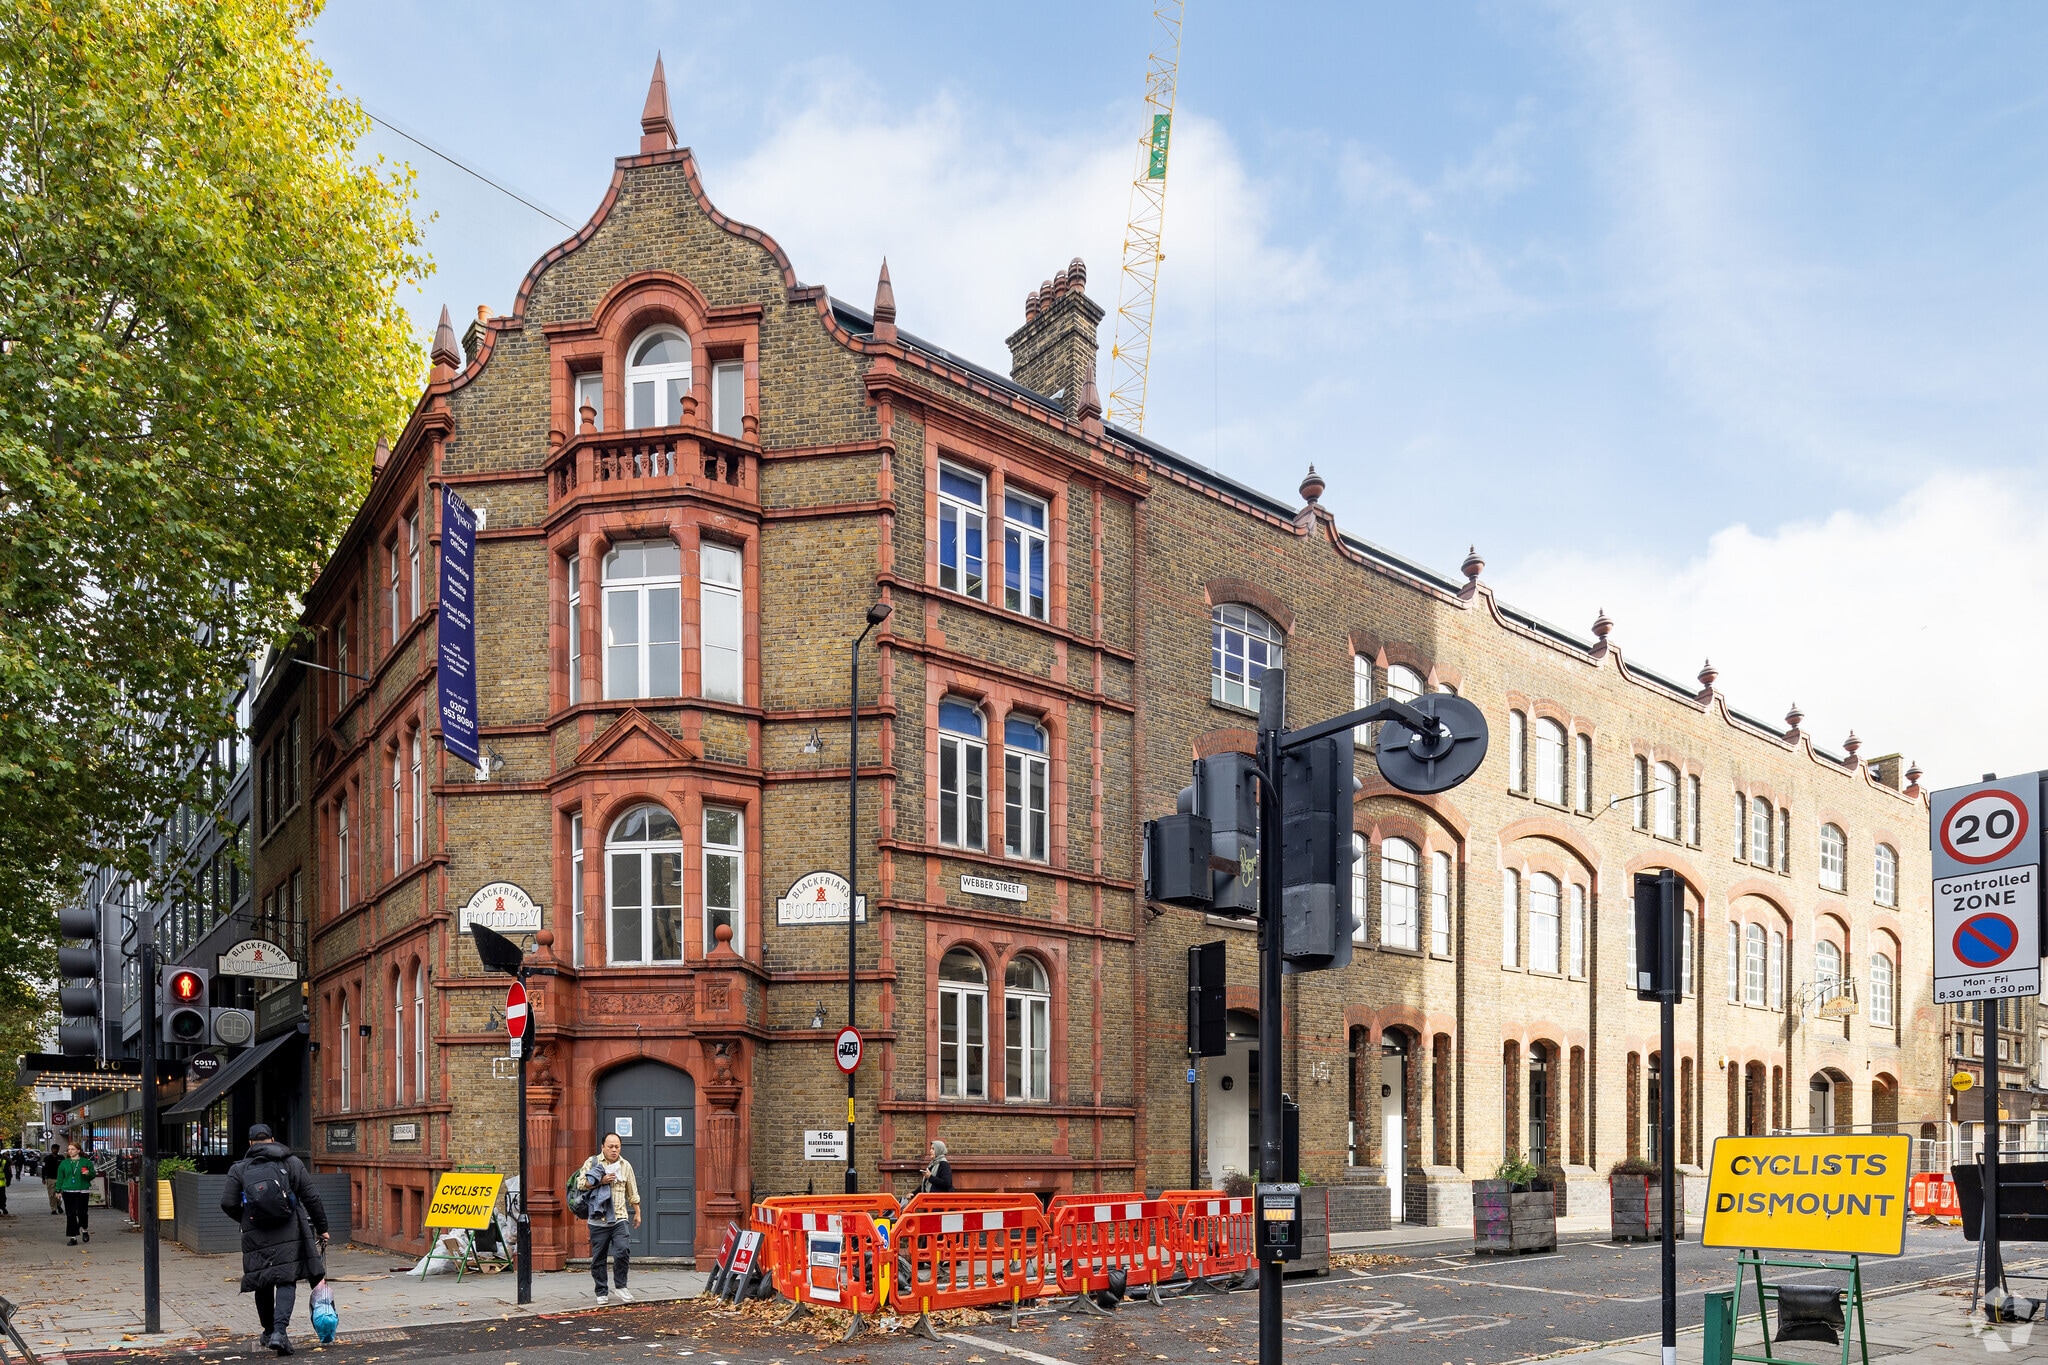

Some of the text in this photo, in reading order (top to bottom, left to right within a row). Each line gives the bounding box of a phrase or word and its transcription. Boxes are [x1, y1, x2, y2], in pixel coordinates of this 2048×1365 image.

[453, 504, 473, 531] Space
[448, 527, 468, 549] Serviced
[450, 538, 466, 557] Offices
[445, 555, 470, 581] Coworking
[447, 574, 467, 595] Meeting
[449, 584, 465, 602] Rooms
[442, 598, 471, 625] Virtual Office
[447, 611, 466, 630] Services
[443, 706, 474, 729] 953 8080
[449, 700, 467, 715] 0207
[1955, 809, 2015, 845] 20
[790, 876, 851, 900] BLACKFRIARS
[962, 877, 994, 890] WEBBER
[995, 882, 1020, 894] STREET
[1940, 871, 2030, 895] Controlled
[472, 886, 529, 908] BLACKFRIARS
[1953, 890, 2016, 912] ZONE
[462, 909, 539, 928] FOUNDRY
[231, 942, 287, 962] BLACKFRIARS
[221, 957, 296, 977] FOUNDRY
[1939, 989, 1964, 999] 8.30
[1966, 989, 1981, 997] am
[1989, 984, 2015, 995] 6.30
[2018, 983, 2035, 993] pm
[1963, 977, 1985, 987] Mon
[1994, 975, 2008, 984] Fri
[818, 1132, 834, 1140] 156
[1730, 1154, 1888, 1176] CYCLISTS
[441, 1185, 493, 1197] CYCLISTS
[431, 1203, 491, 1216] DISMOUNT
[1265, 1209, 1292, 1220] WAIT
[1715, 1192, 1895, 1217] DISMOUNT
[740, 1251, 747, 1260] No
[734, 1261, 748, 1271] smoking
